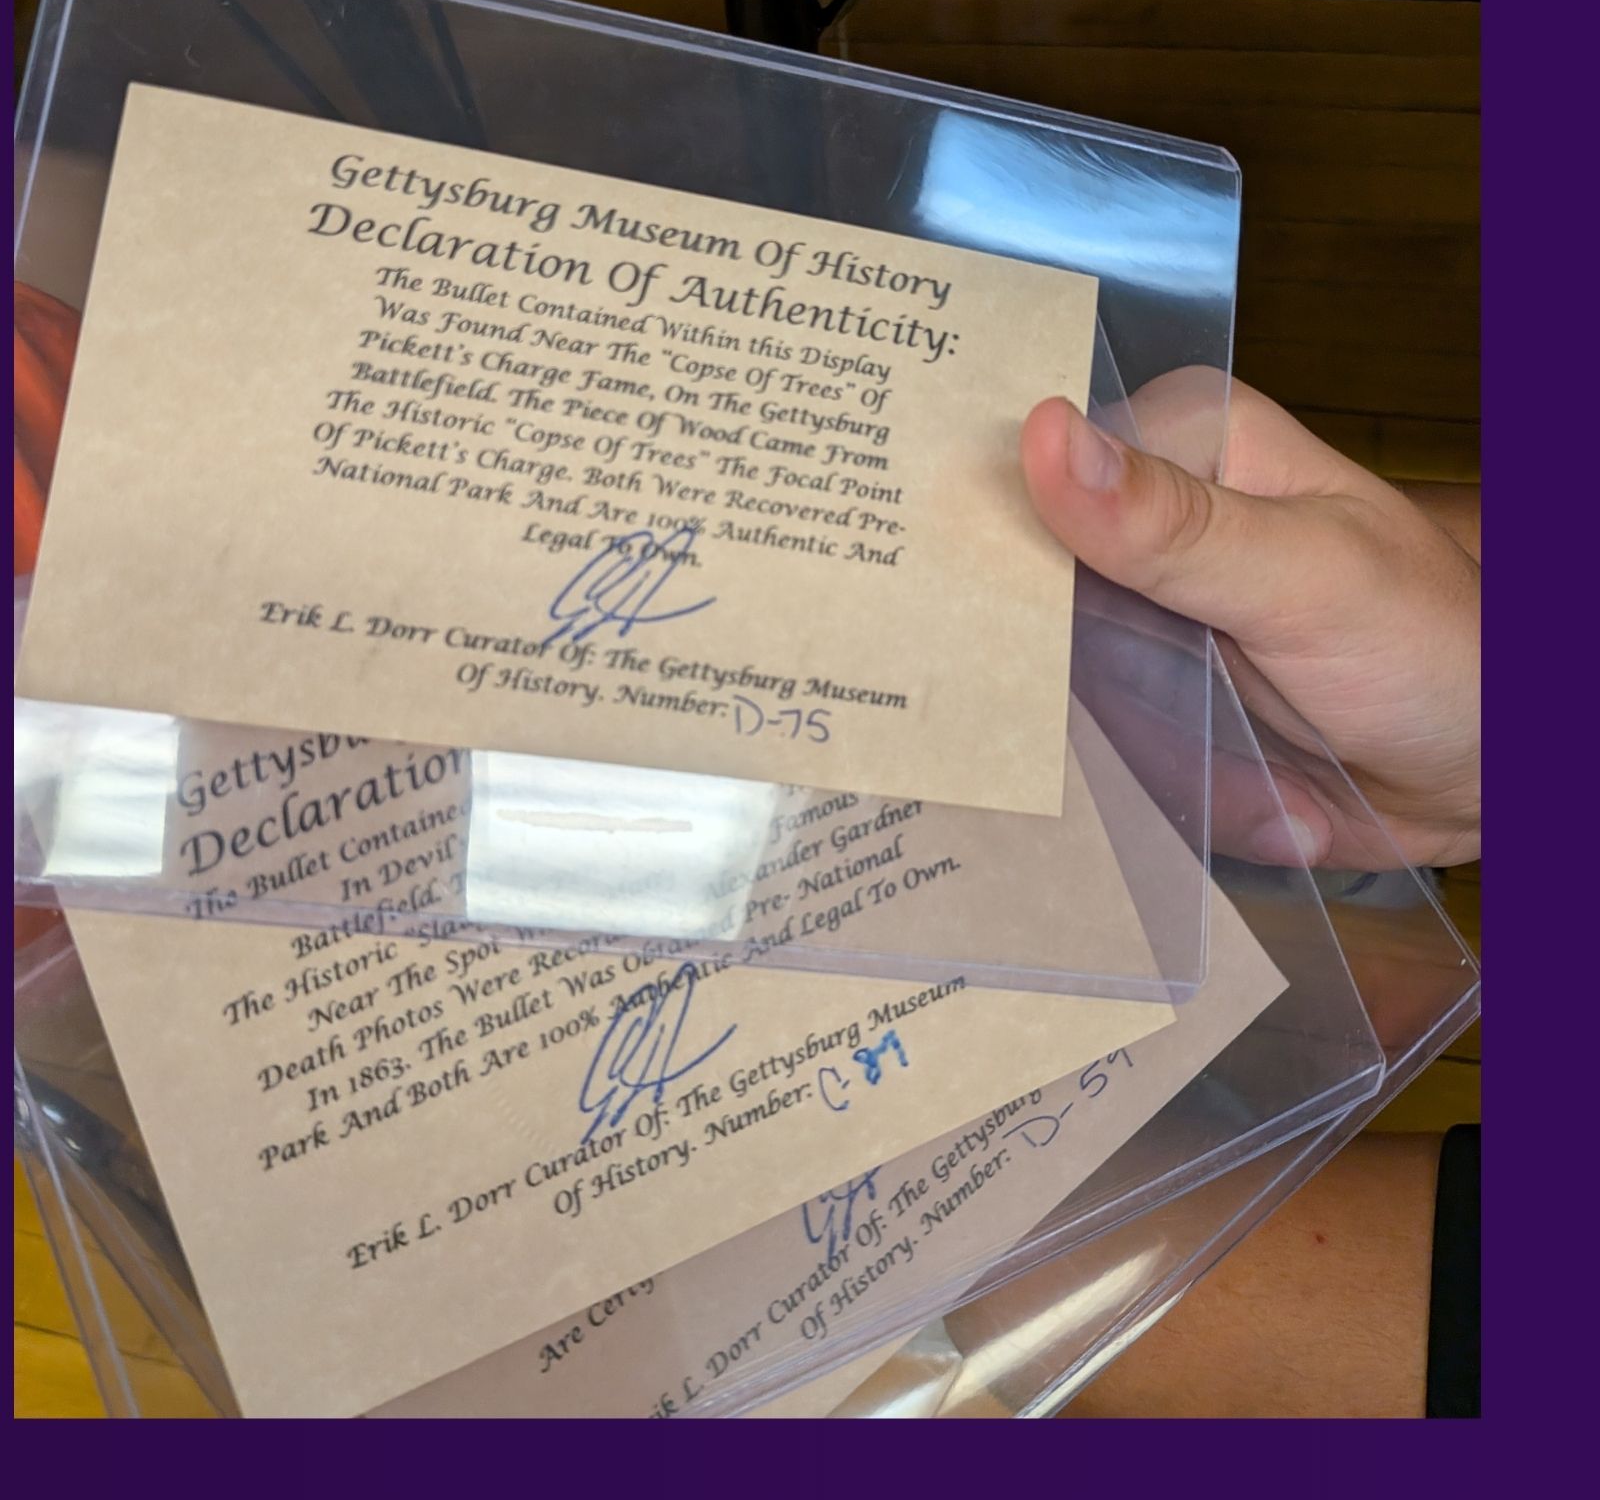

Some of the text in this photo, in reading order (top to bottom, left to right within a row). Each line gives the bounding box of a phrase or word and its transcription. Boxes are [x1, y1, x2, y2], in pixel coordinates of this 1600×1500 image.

[307, 202, 960, 364] Declaration Of Authenticity:
[330, 154, 952, 311] Gettysburg Museum Of History
[375, 266, 892, 384] The Bullet Contained Within this Display
[259, 601, 324, 629] Erik
[328, 610, 355, 634] L.
[365, 615, 439, 645] Dorr
[443, 626, 551, 659] Curator
[603, 647, 652, 674] The
[657, 655, 798, 701] Gettysburg
[801, 677, 909, 710] Museum
[455, 662, 730, 718] Of History. Number:
[733, 696, 832, 744] D-75
[306, 964, 616, 1113] In 1863. The Bullet Was
[345, 977, 968, 1270] Erik L. Dorr Curator Of: The Gettysburg Museum
[553, 1081, 813, 1217] Of History. Number:
[799, 1138, 1010, 1341] Of History. Number:
